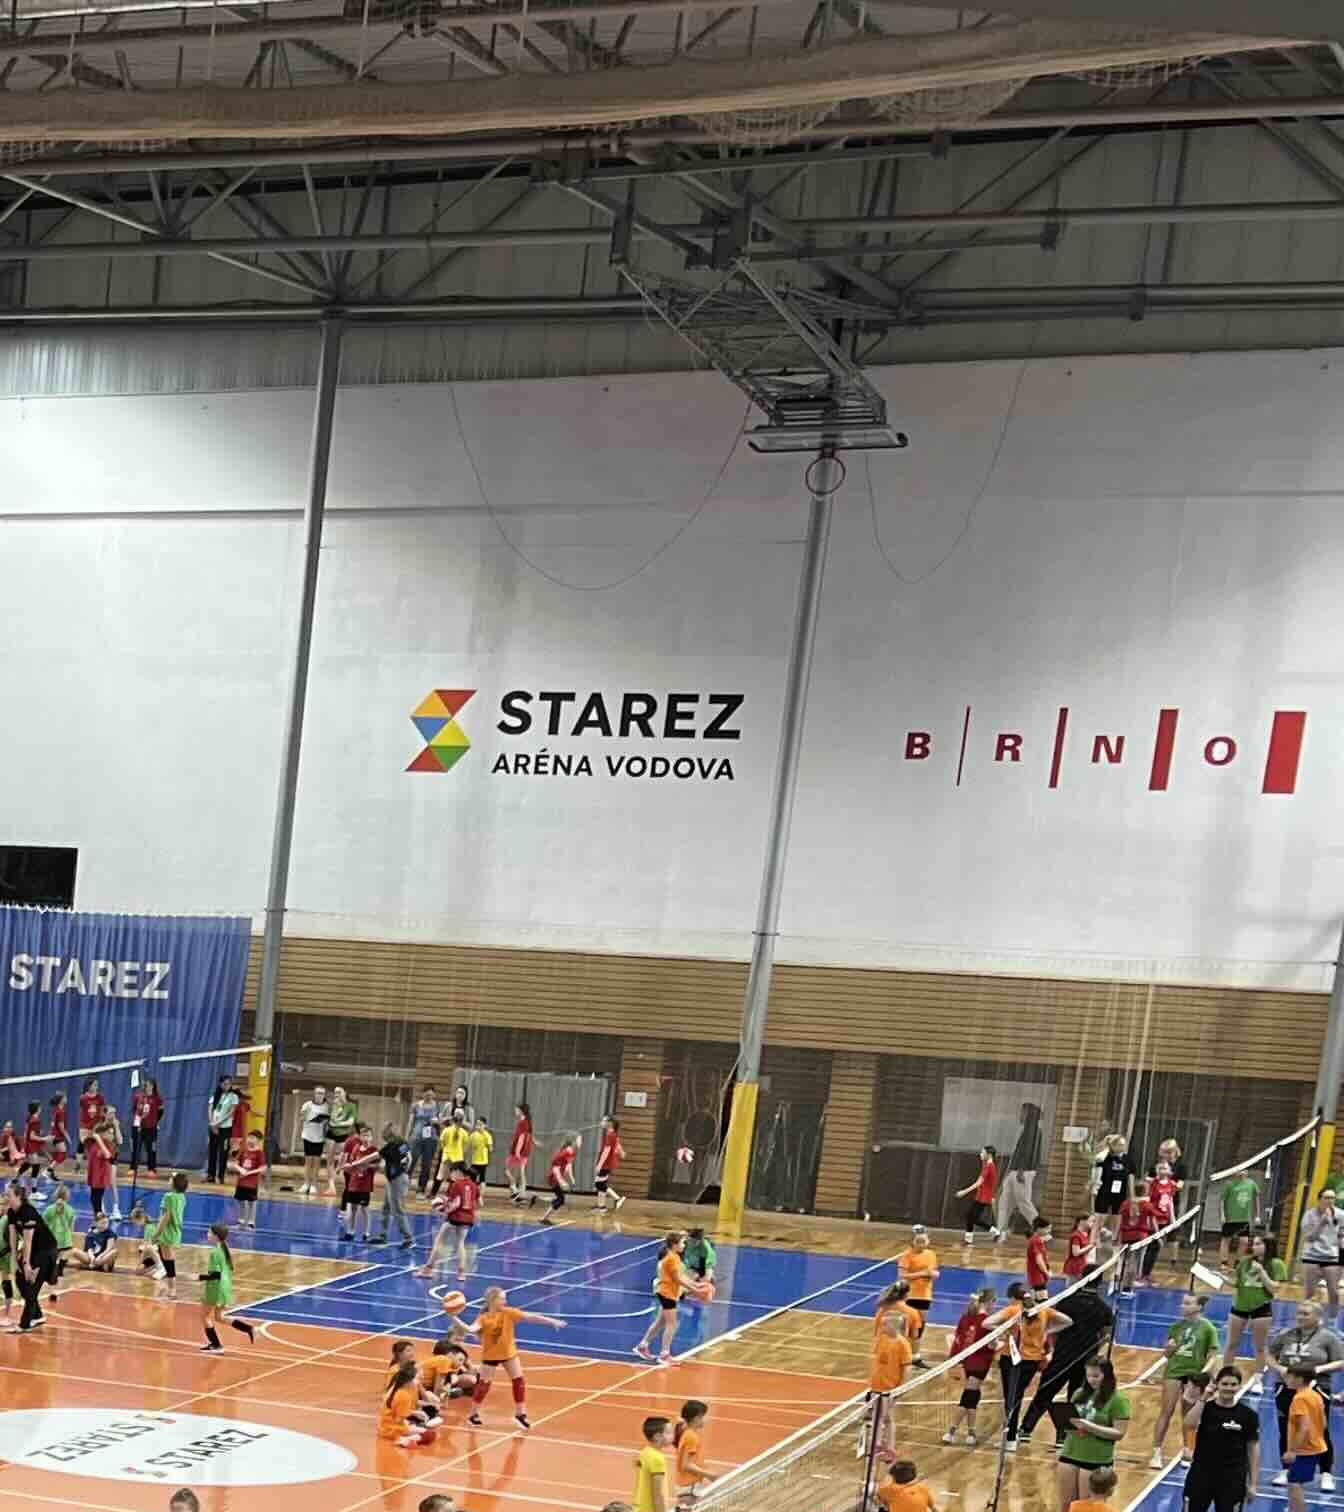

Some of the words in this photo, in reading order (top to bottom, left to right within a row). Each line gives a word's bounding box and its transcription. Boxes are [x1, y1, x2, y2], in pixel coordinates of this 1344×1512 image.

[497, 690, 745, 740] STAREZ
[491, 748, 593, 776] ARÉNA
[606, 755, 734, 780] VODOVA
[9, 953, 171, 999] STAREZ
[145, 1429, 269, 1469] STAREZ
